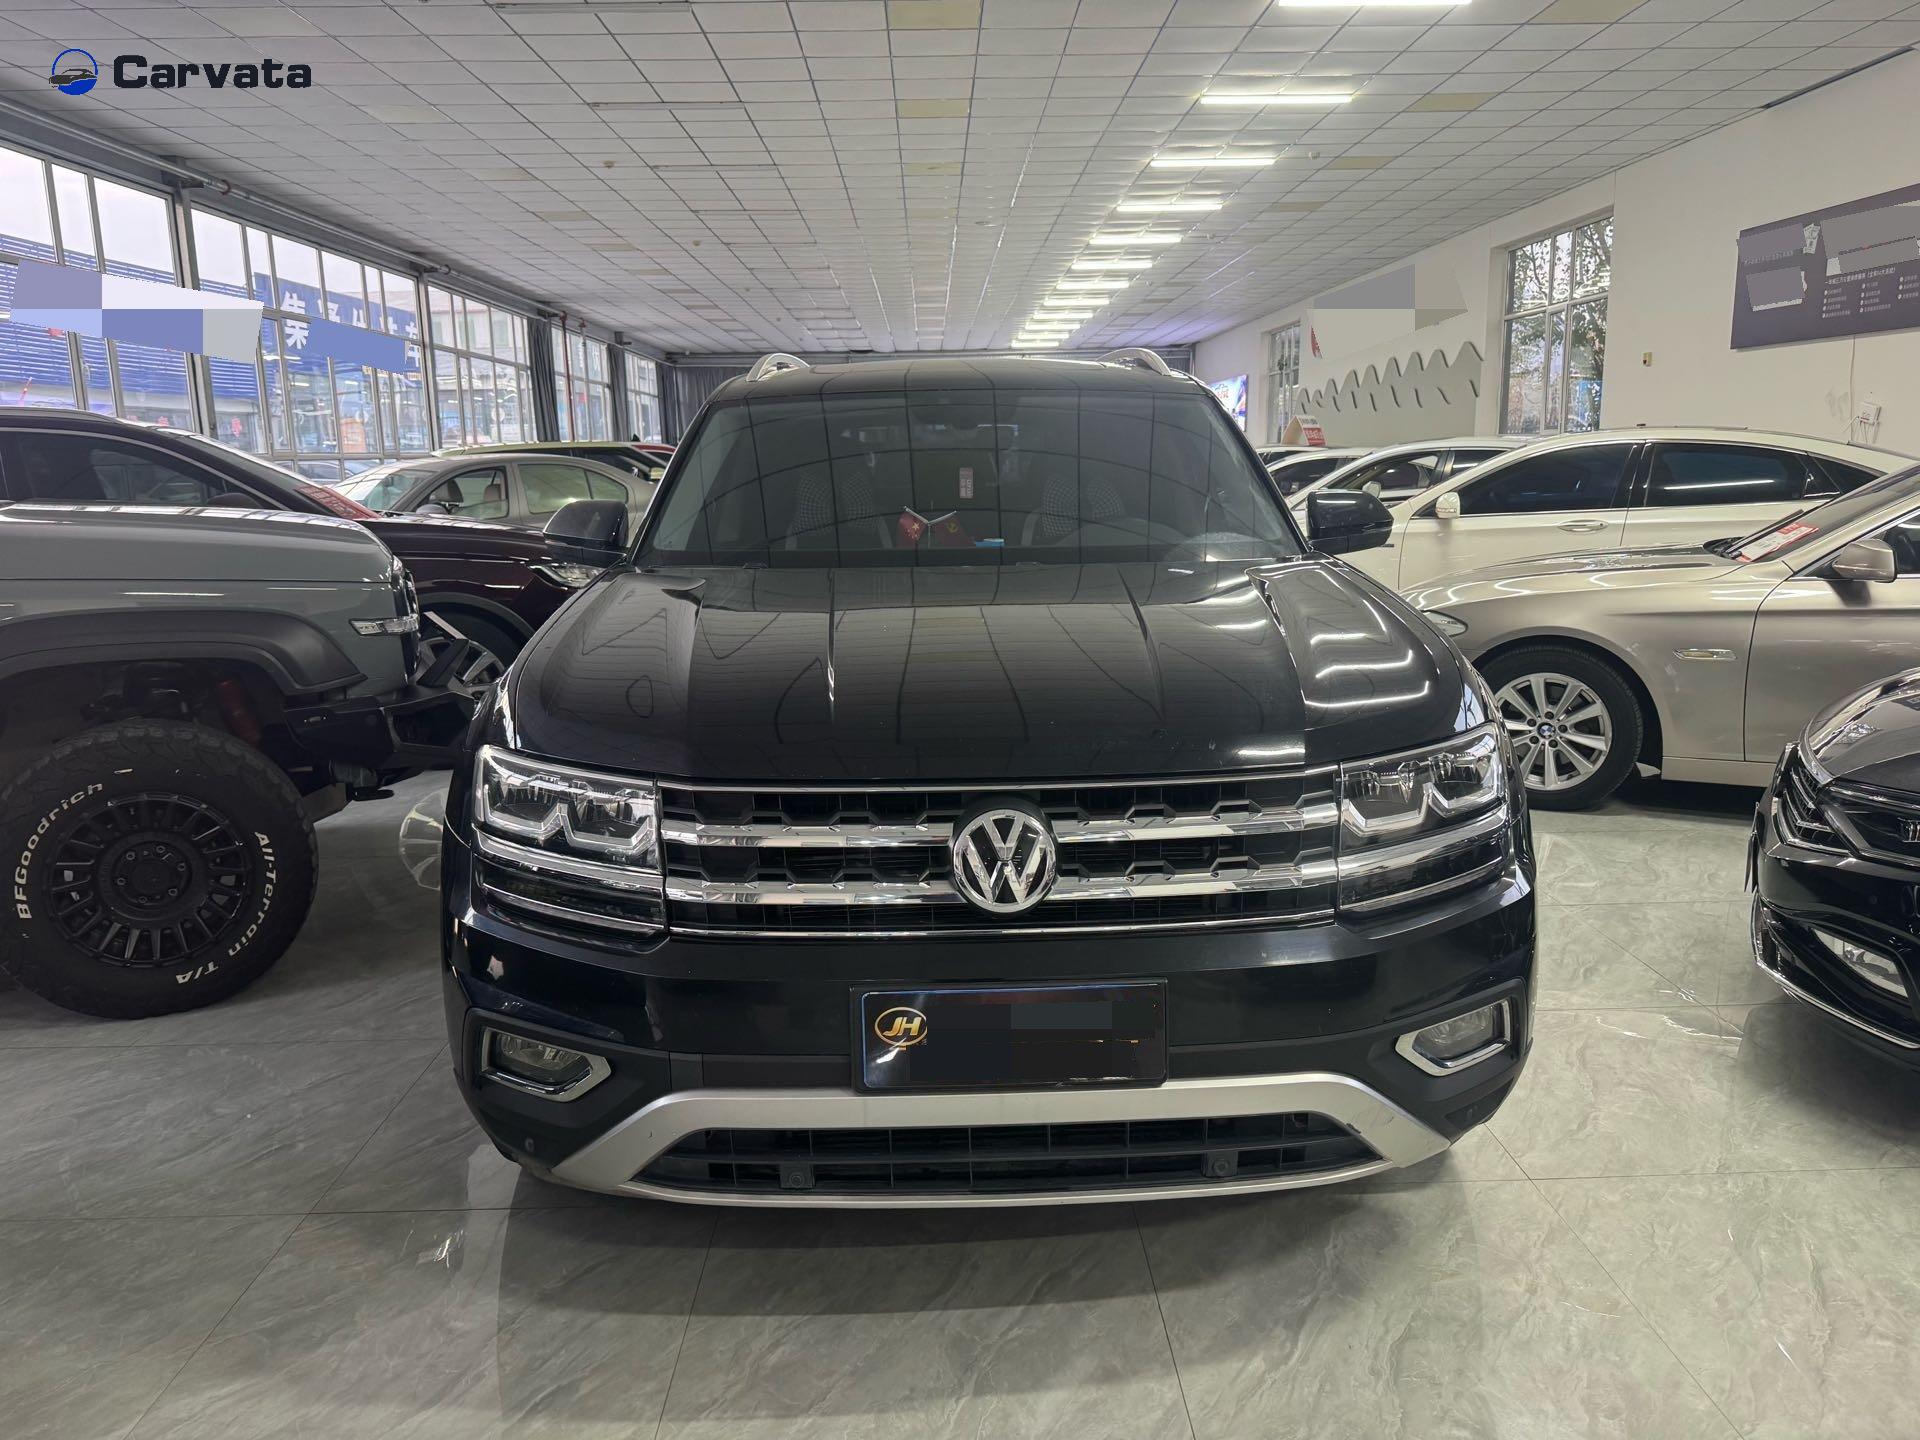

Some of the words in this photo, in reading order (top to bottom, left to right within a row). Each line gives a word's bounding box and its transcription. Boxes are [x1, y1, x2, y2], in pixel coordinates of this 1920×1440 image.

[14, 782, 104, 919] BFGoodrich
[227, 831, 277, 956] All-Terrain
[959, 811, 1051, 906] VW
[175, 961, 219, 984] T/A
[882, 1016, 922, 1037] JH
